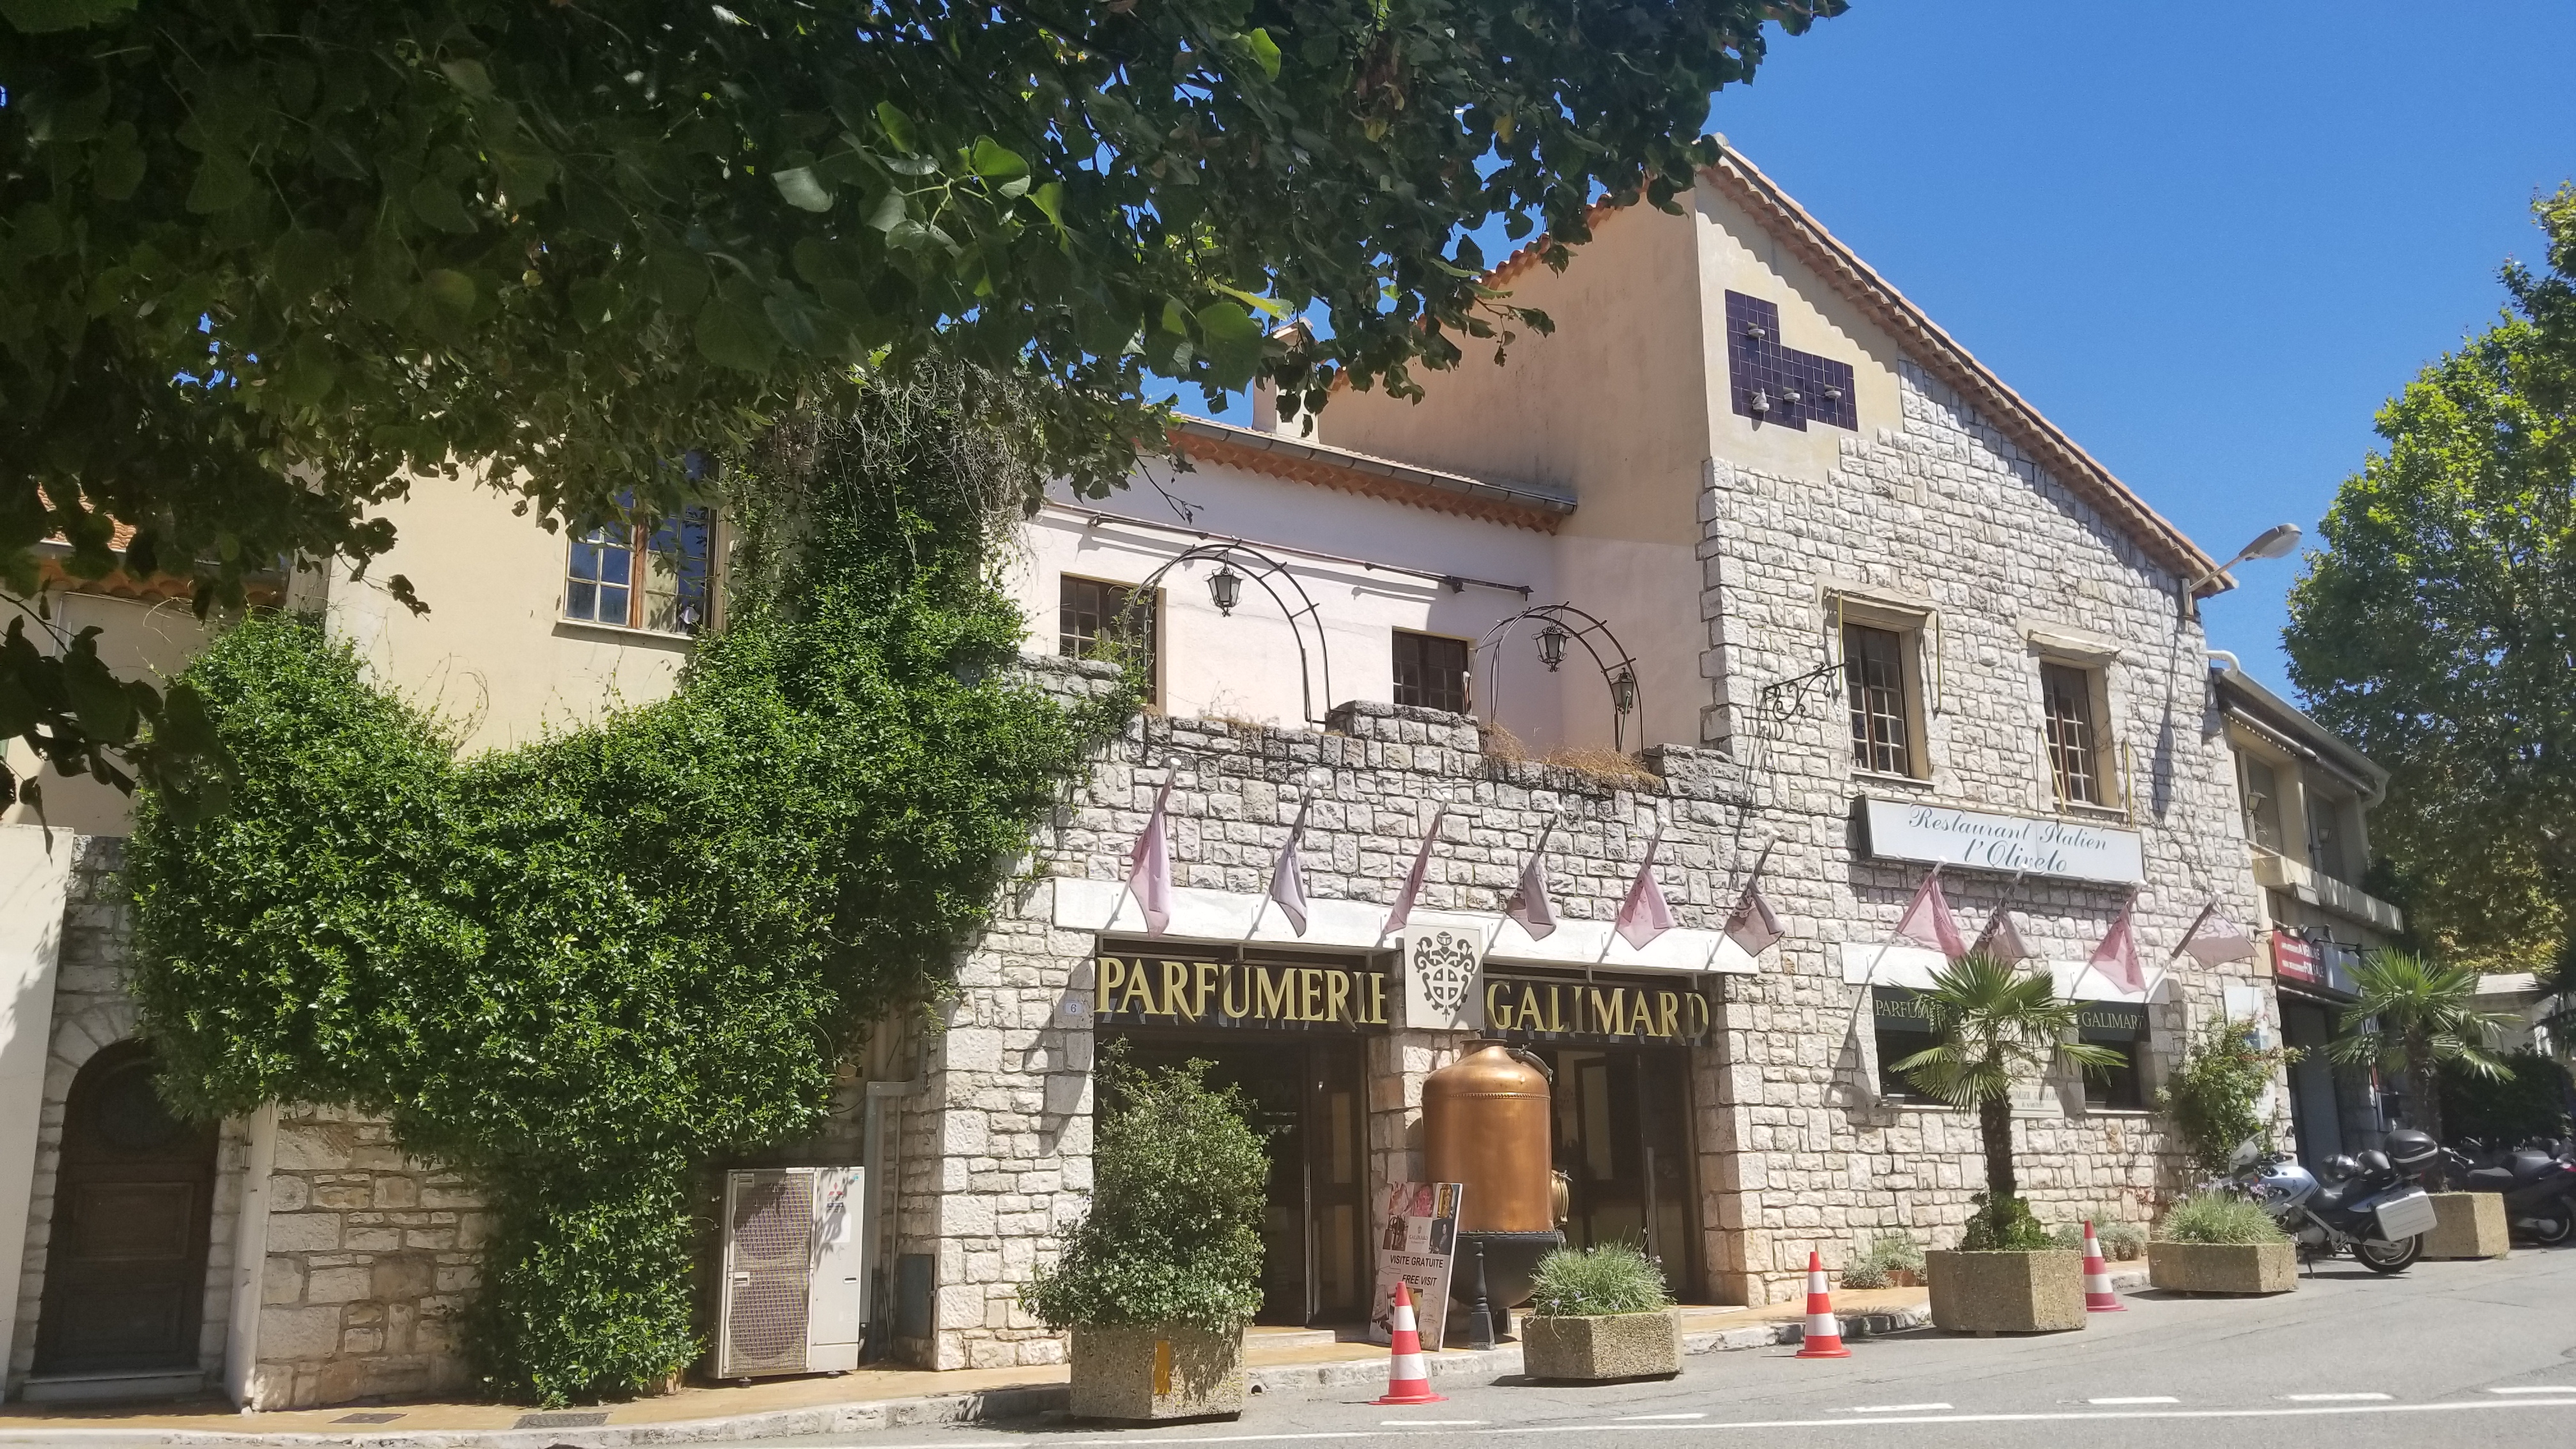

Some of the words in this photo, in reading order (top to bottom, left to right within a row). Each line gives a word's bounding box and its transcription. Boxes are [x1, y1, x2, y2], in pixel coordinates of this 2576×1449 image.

[1910, 806, 2030, 840] Restaurant
[2039, 824, 2108, 851] Italien
[1094, 957, 1388, 1028] PARFUMERIE
[1487, 981, 1708, 1045] GALIMARD
[1070, 1004, 1077, 1013] 6
[1390, 1254, 1410, 1265] VISITE
[1411, 1257, 1444, 1268] GRATUITE
[1402, 1274, 1420, 1285] FREE
[1421, 1275, 1438, 1287] VISIT
